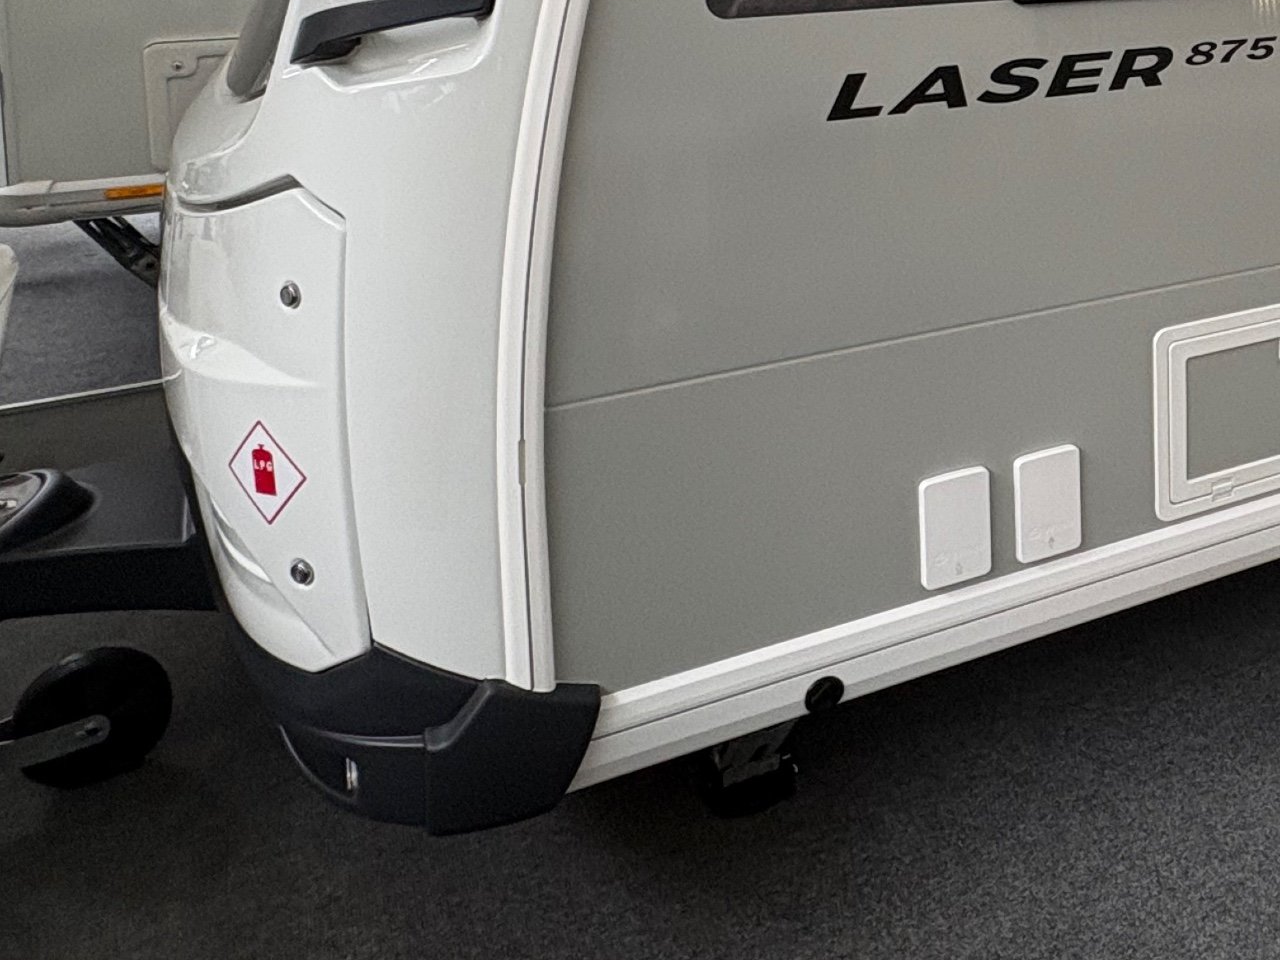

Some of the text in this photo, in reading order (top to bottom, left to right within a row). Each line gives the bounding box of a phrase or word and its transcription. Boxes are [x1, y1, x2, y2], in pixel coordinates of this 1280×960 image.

[826, 36, 1277, 121] LASER 875
[253, 458, 273, 472] LPG
